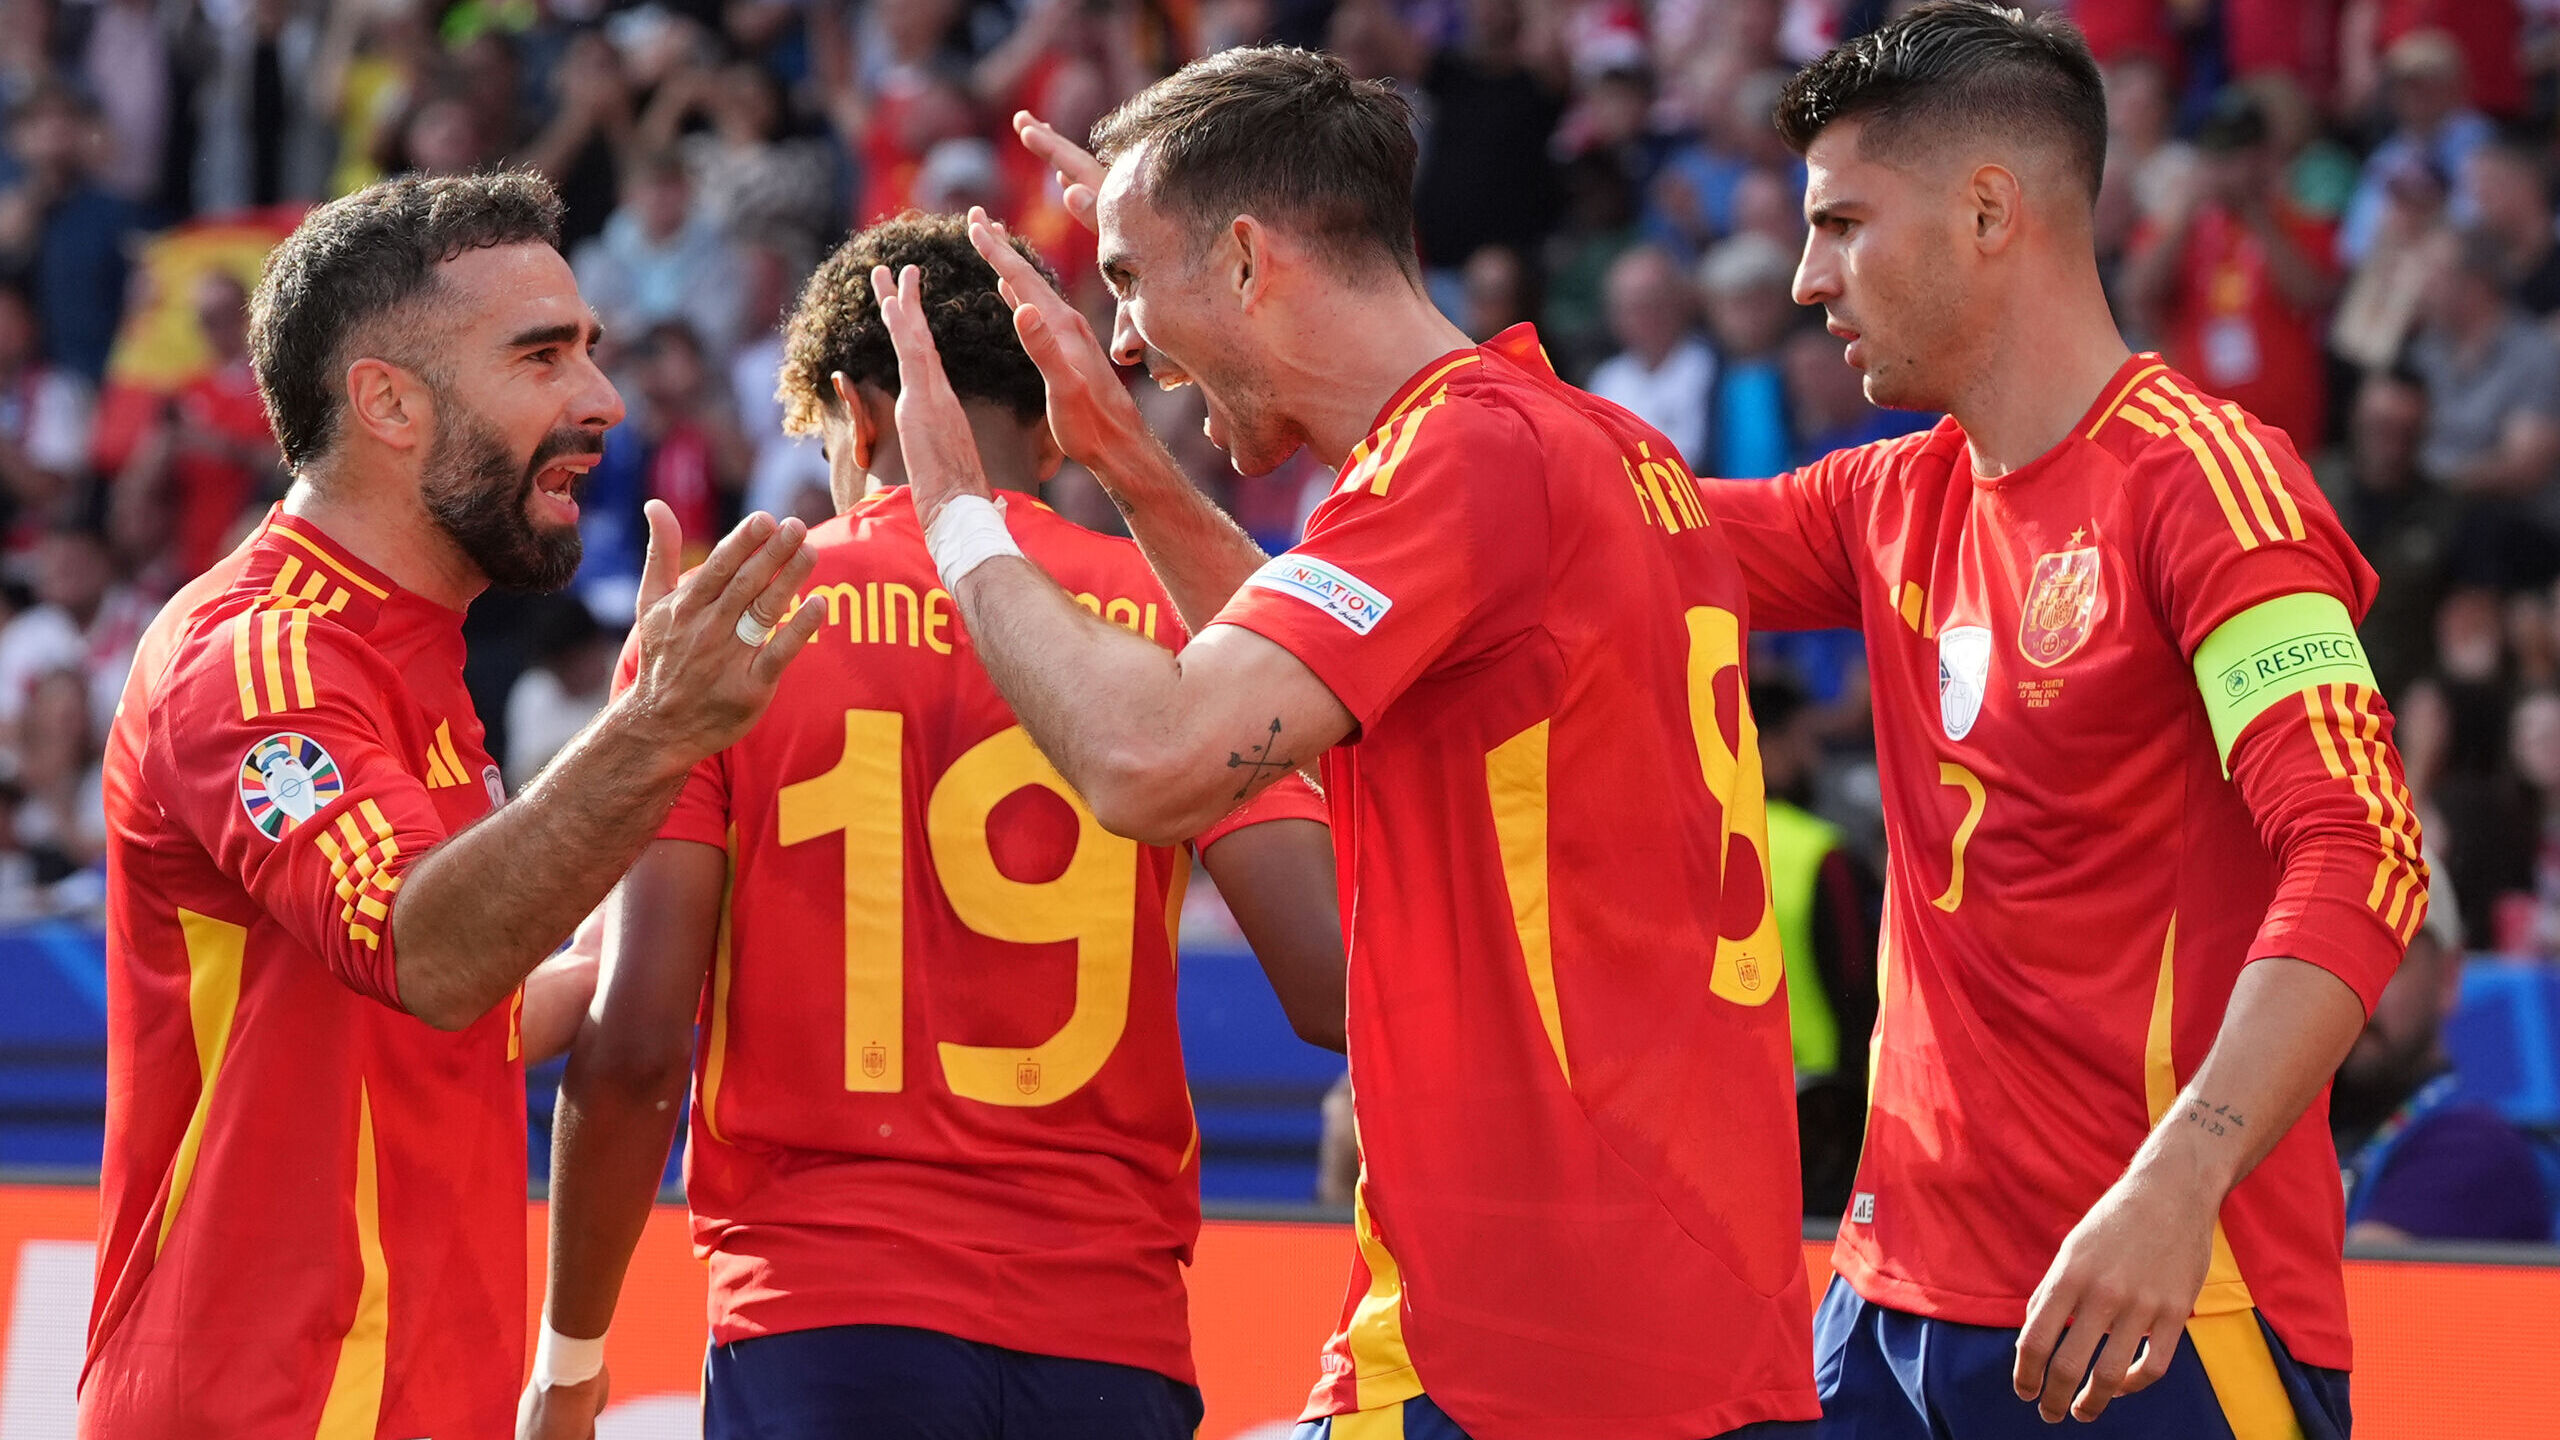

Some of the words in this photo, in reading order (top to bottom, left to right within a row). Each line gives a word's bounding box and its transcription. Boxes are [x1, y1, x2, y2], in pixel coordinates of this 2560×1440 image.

[2255, 639, 2358, 680] RESPECT
[778, 709, 1138, 1107] 19
[1931, 761, 1987, 914] 7
